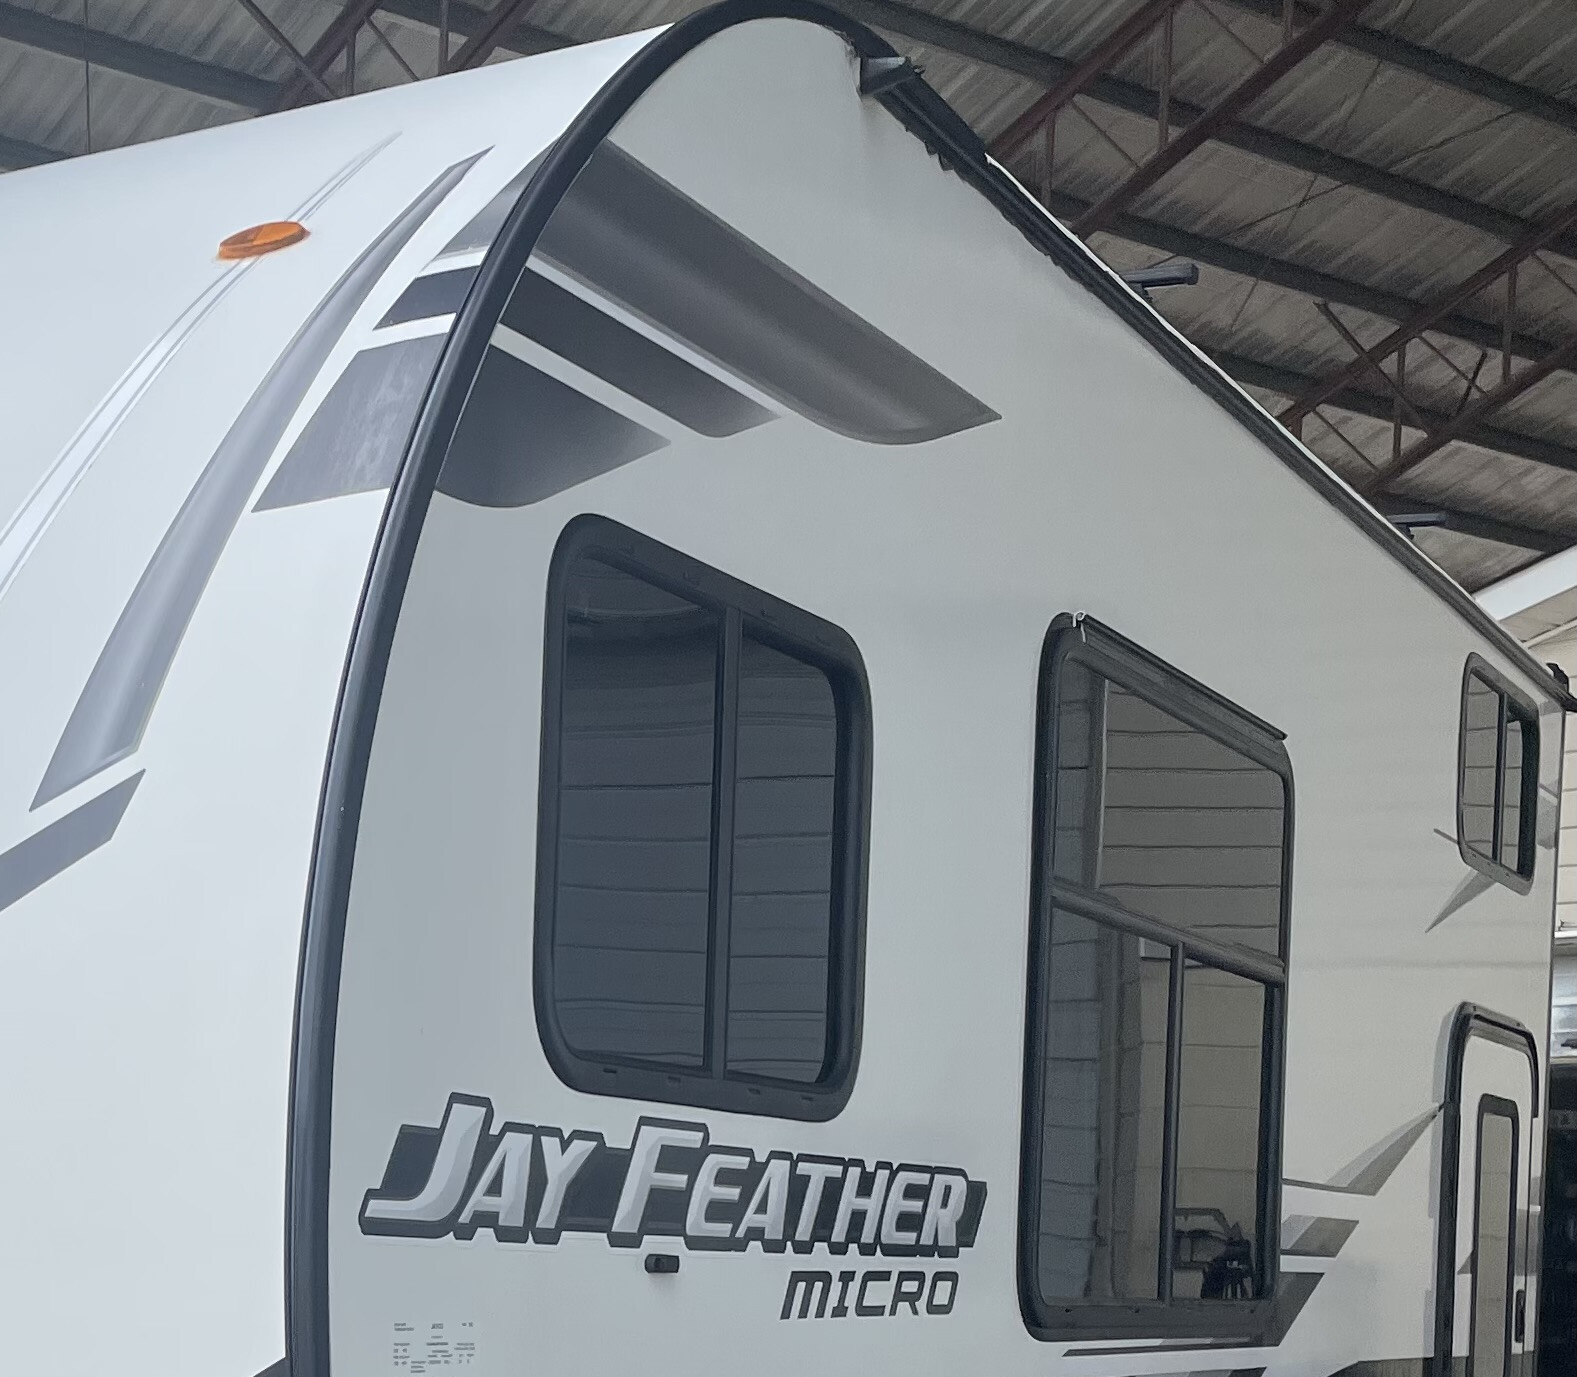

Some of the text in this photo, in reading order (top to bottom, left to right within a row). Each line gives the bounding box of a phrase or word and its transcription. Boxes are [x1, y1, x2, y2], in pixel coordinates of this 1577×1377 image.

[360, 1095, 970, 1254] JAY FEATHER
[779, 1270, 960, 1320] MICRO
